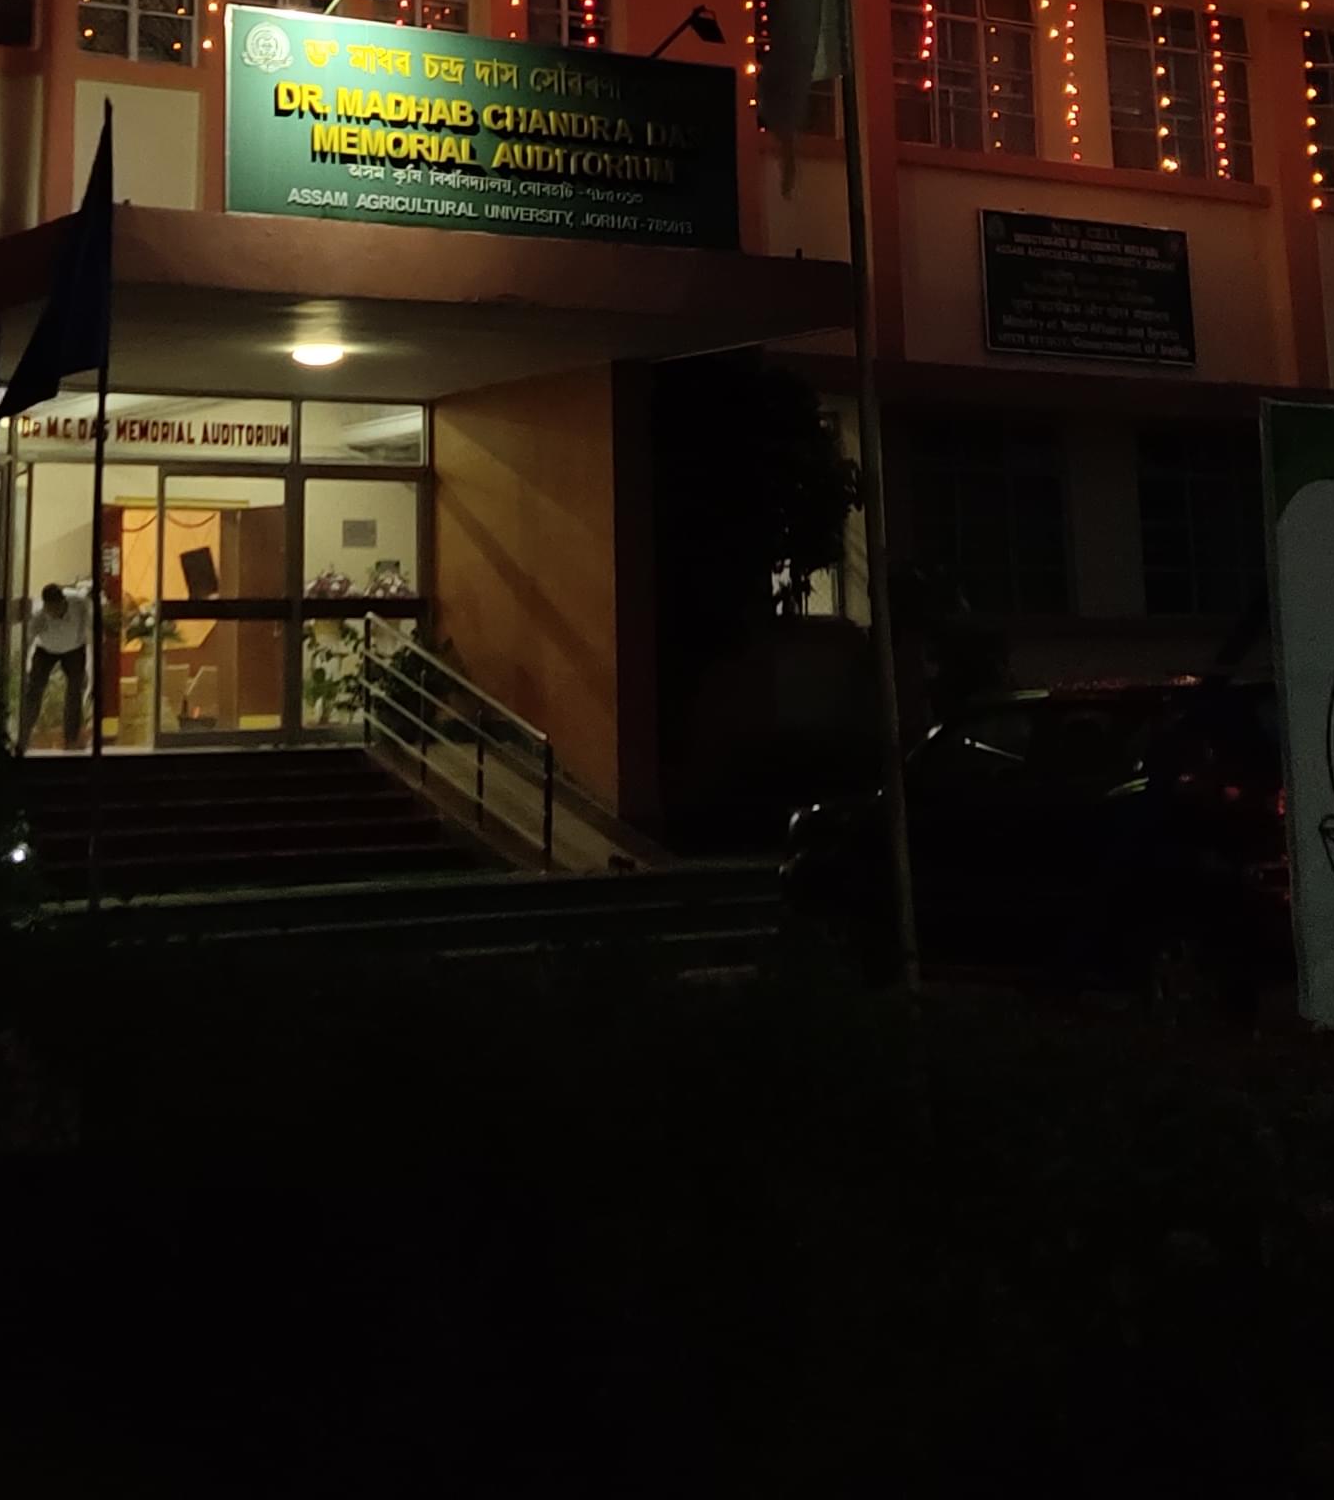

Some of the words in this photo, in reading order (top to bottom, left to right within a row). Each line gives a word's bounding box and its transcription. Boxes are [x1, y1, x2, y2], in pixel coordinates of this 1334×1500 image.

[474, 58, 519, 90] দাস
[276, 81, 331, 115] DR.
[336, 86, 476, 129] MADHAB
[482, 102, 634, 145] CHANDRA
[646, 120, 701, 150] DAS
[311, 123, 479, 165] MEMORIAL
[490, 140, 677, 184] AUDITORIUM
[287, 188, 348, 208] ASSAM
[355, 193, 479, 218] AGRICULTURAL
[483, 203, 575, 229] UNIVERSITY,
[117, 419, 195, 444] MEMORIAL
[200, 421, 289, 447] AUDITORIUM
